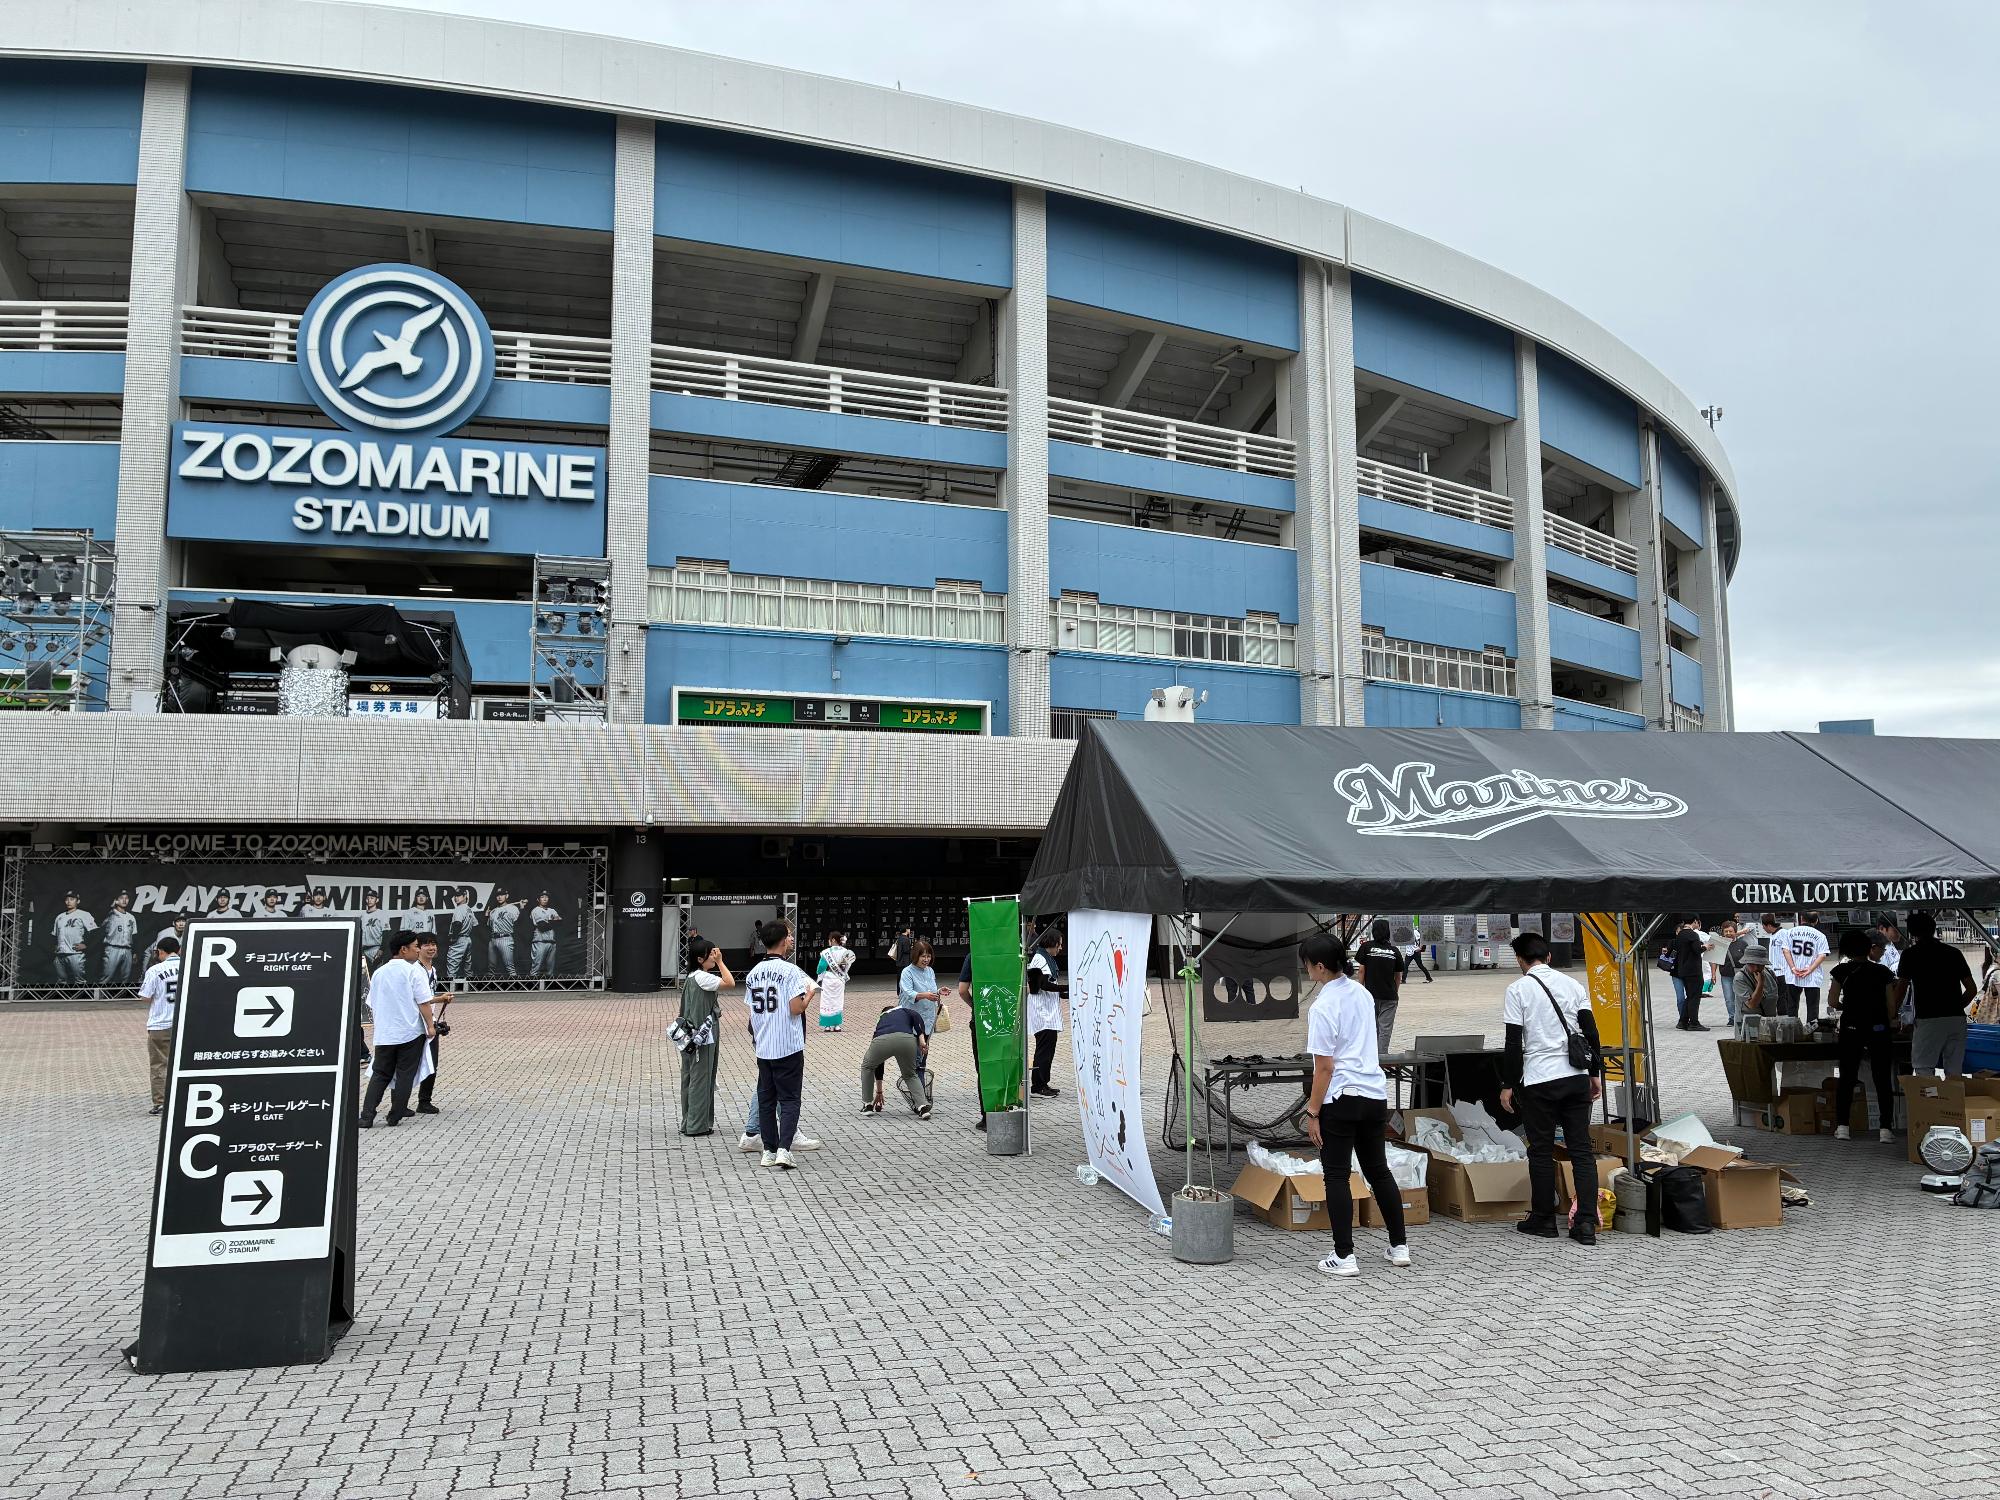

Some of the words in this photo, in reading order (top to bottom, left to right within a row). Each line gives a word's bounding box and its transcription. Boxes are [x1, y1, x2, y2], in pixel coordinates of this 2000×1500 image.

[178, 430, 596, 500] ZOZOMARINE
[292, 496, 490, 541] STADIUM
[346, 701, 418, 713] 場券売場
[703, 700, 766, 717] コアラのマーチ
[833, 704, 842, 713] C
[902, 708, 958, 725] コアラのマーチ
[1334, 762, 1688, 832] Marines
[105, 834, 226, 851] WELCOME
[231, 835, 263, 851] TO
[268, 835, 412, 851] ZOZOMARINE
[416, 835, 508, 851] STADIUM
[635, 835, 647, 844] 13
[131, 884, 222, 914] PLAY
[313, 886, 384, 911] WIN
[1731, 883, 1797, 904] CHIBA
[1803, 882, 1869, 904] LOTTE
[1876, 879, 1966, 901] MARINES
[415, 921, 424, 929] 32
[1792, 940, 1815, 957] 56
[199, 937, 240, 978] R
[751, 986, 778, 1014] 56
[193, 1048, 325, 1061] 階段をのぼらずお進みください
[184, 1083, 224, 1127] B
[228, 1100, 331, 1114] キシリトールゲート
[262, 1113, 284, 1121] GATE
[228, 1140, 323, 1153] コアラのマーチゲート
[179, 1133, 221, 1179] C
[258, 1154, 280, 1162] GATE
[228, 1246, 260, 1254] STADIUM
[229, 1238, 276, 1247] ZOZOMARINE
